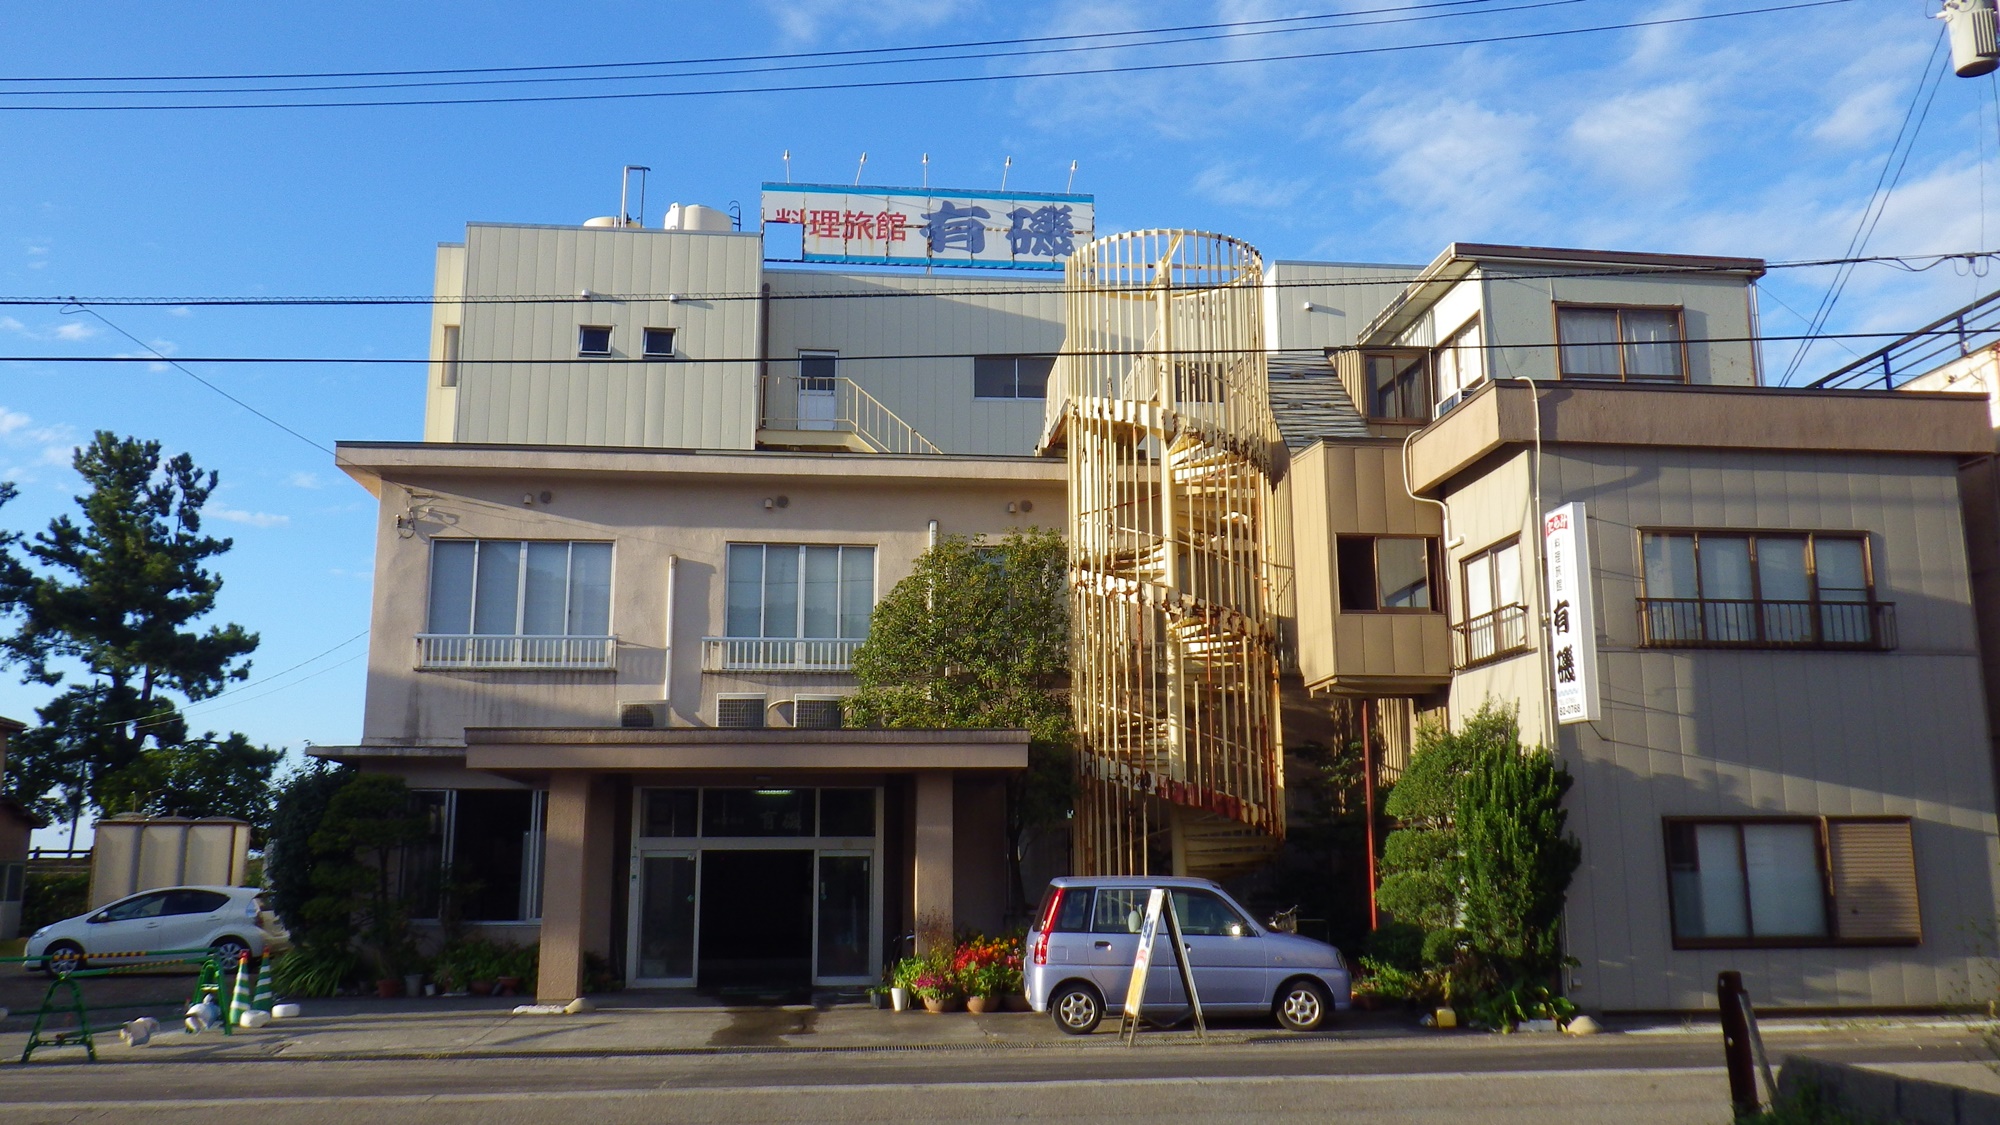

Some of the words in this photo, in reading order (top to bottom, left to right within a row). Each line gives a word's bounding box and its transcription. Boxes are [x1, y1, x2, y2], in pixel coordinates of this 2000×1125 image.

[920, 200, 1076, 257] 有磯
[1553, 599, 1576, 684] 有磯
[1559, 703, 1581, 717] 82-0768
